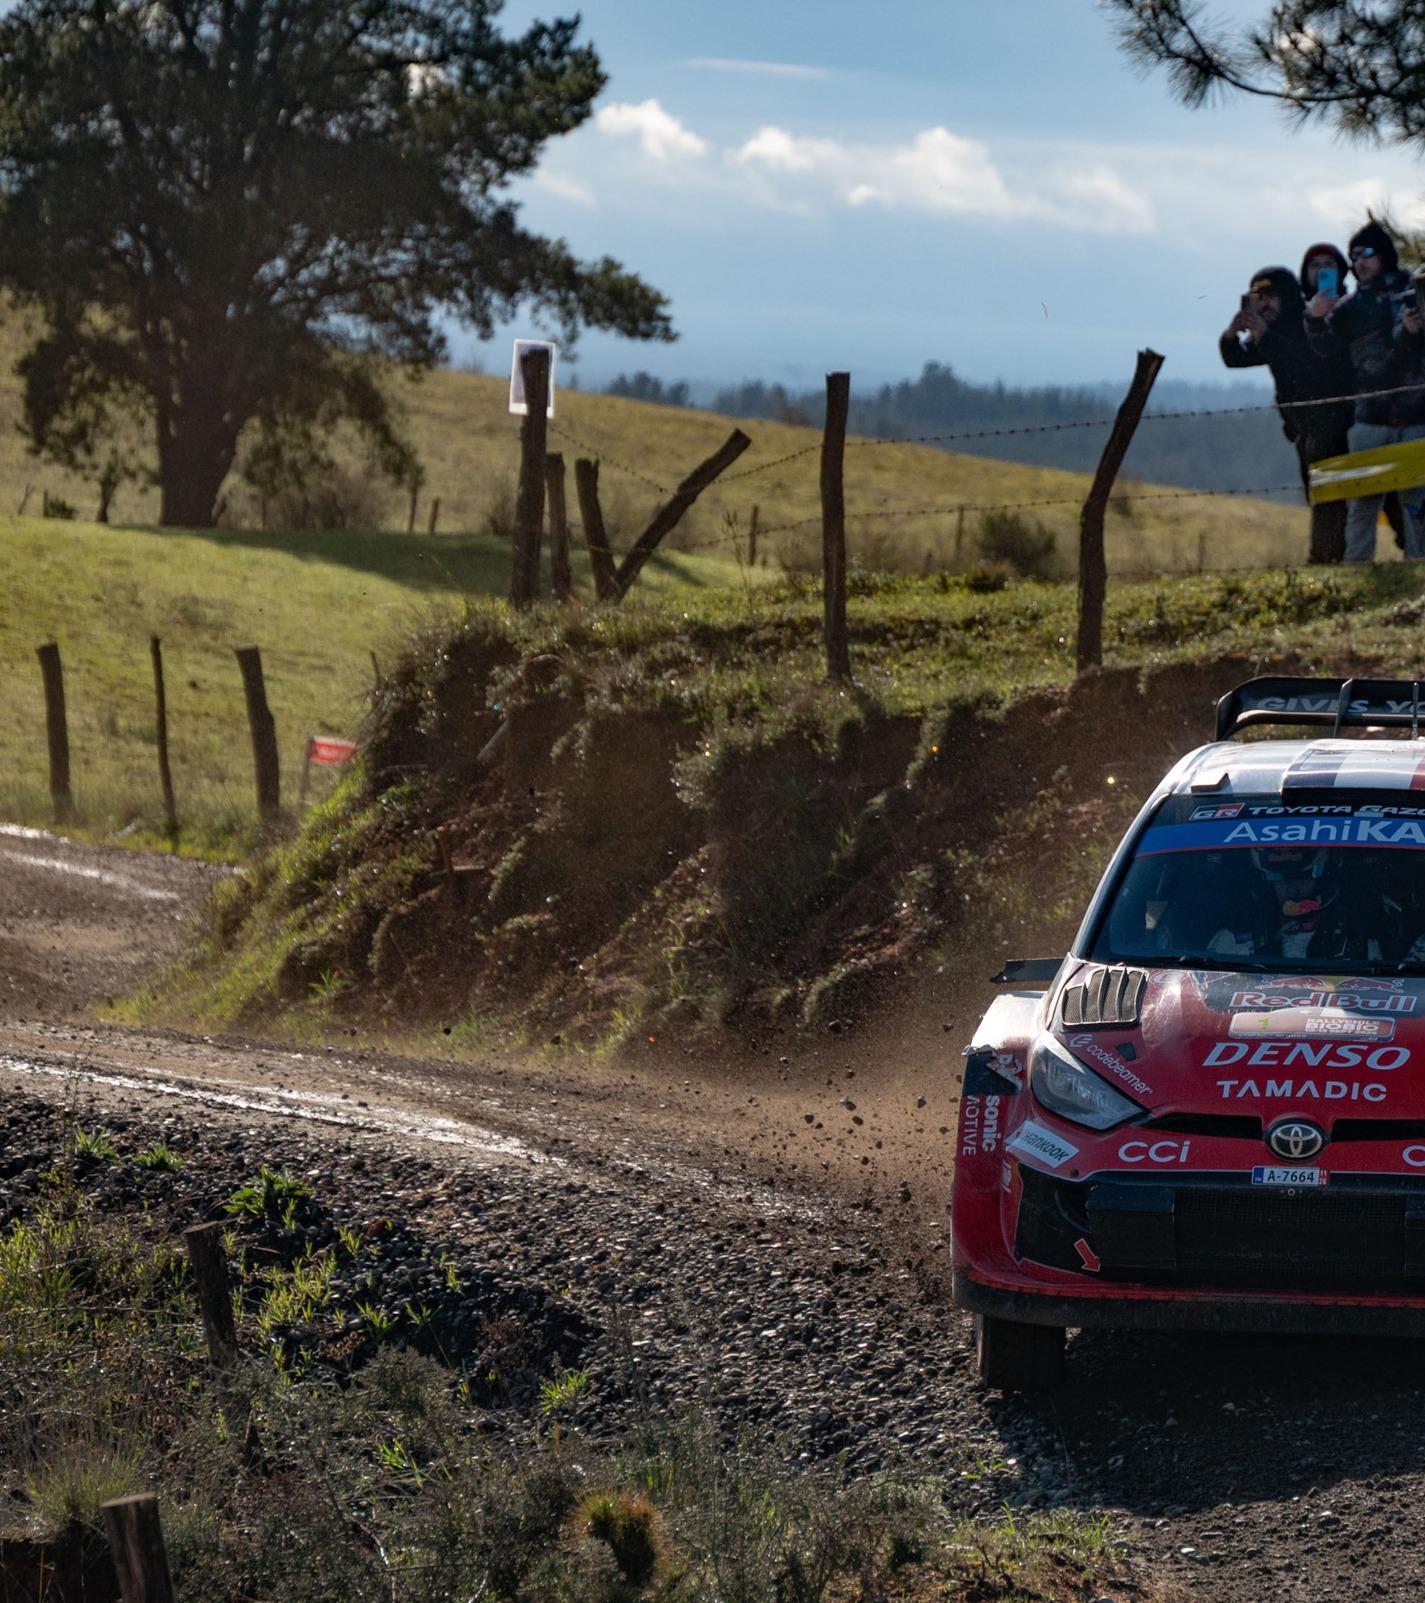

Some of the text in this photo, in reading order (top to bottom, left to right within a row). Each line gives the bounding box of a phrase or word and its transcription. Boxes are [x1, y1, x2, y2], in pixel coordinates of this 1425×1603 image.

[1256, 696, 1369, 713] GIVES
[1192, 808, 1238, 820] GR
[1248, 805, 1352, 815] TOYOTA
[1229, 991, 1417, 1012] Red Bull
[1202, 1042, 1411, 1070] DENSO
[1086, 1043, 1153, 1095] codebeamer
[1216, 1080, 1388, 1102] TAMADIC
[1267, 1170, 1315, 1183] A-7664
